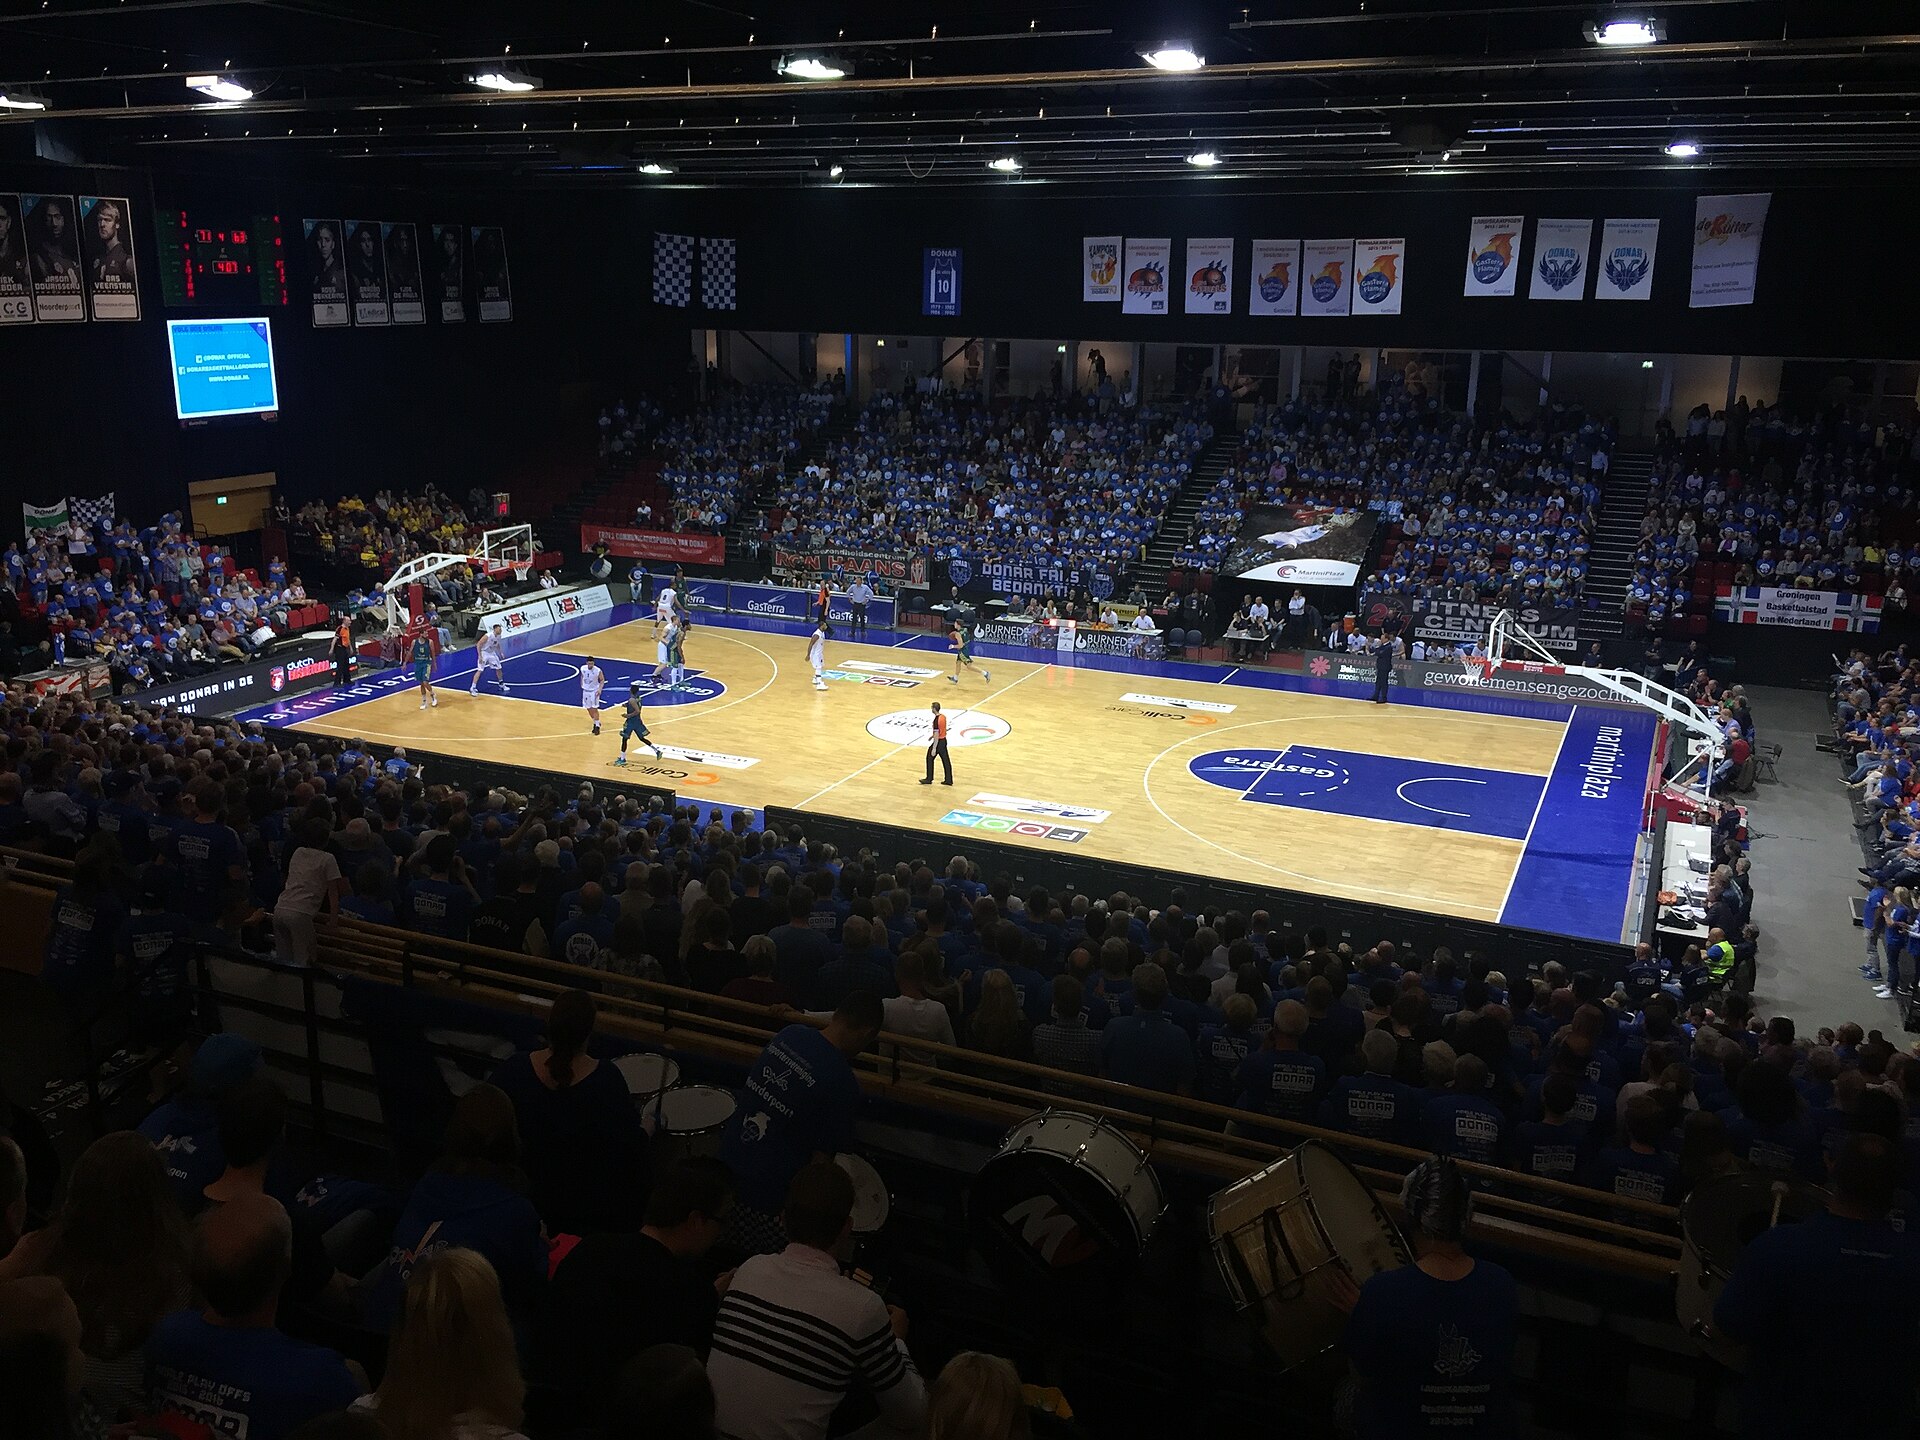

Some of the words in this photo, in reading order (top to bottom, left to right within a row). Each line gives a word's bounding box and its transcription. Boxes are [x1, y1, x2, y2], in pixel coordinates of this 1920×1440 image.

[930, 248, 957, 258] DONAR
[1547, 247, 1576, 258] DONAR
[1613, 247, 1643, 258] DONAR
[937, 279, 950, 293] 10
[775, 552, 820, 571] RON
[827, 555, 907, 578] HAANS
[982, 563, 1034, 580] DONAR
[684, 594, 705, 605] Terra
[1776, 590, 1821, 602] Groningen
[746, 600, 785, 615] GasTerra
[1766, 602, 1828, 615] Basketbalstad
[1760, 616, 1777, 624] van
[1778, 616, 1822, 629] Nederland
[985, 624, 1024, 637] BURNED
[1426, 630, 1461, 641] DAGEN
[1087, 633, 1128, 647] BURNED
[286, 656, 314, 671] dutch
[1340, 664, 1377, 677] Belangrijk
[1337, 673, 1360, 682] mooie
[179, 686, 220, 702] DONAR
[222, 681, 235, 691] IN
[239, 675, 254, 687] DE
[246, 669, 416, 725] artiniplaz
[1223, 755, 1336, 779] GasTerra
[1579, 725, 1626, 799] martiniplaza
[605, 761, 689, 779] ColliCe
[1275, 1073, 1314, 1085] DONAR
[1351, 1099, 1393, 1112] DONAR
[218, 1383, 252, 1403] OFFS
